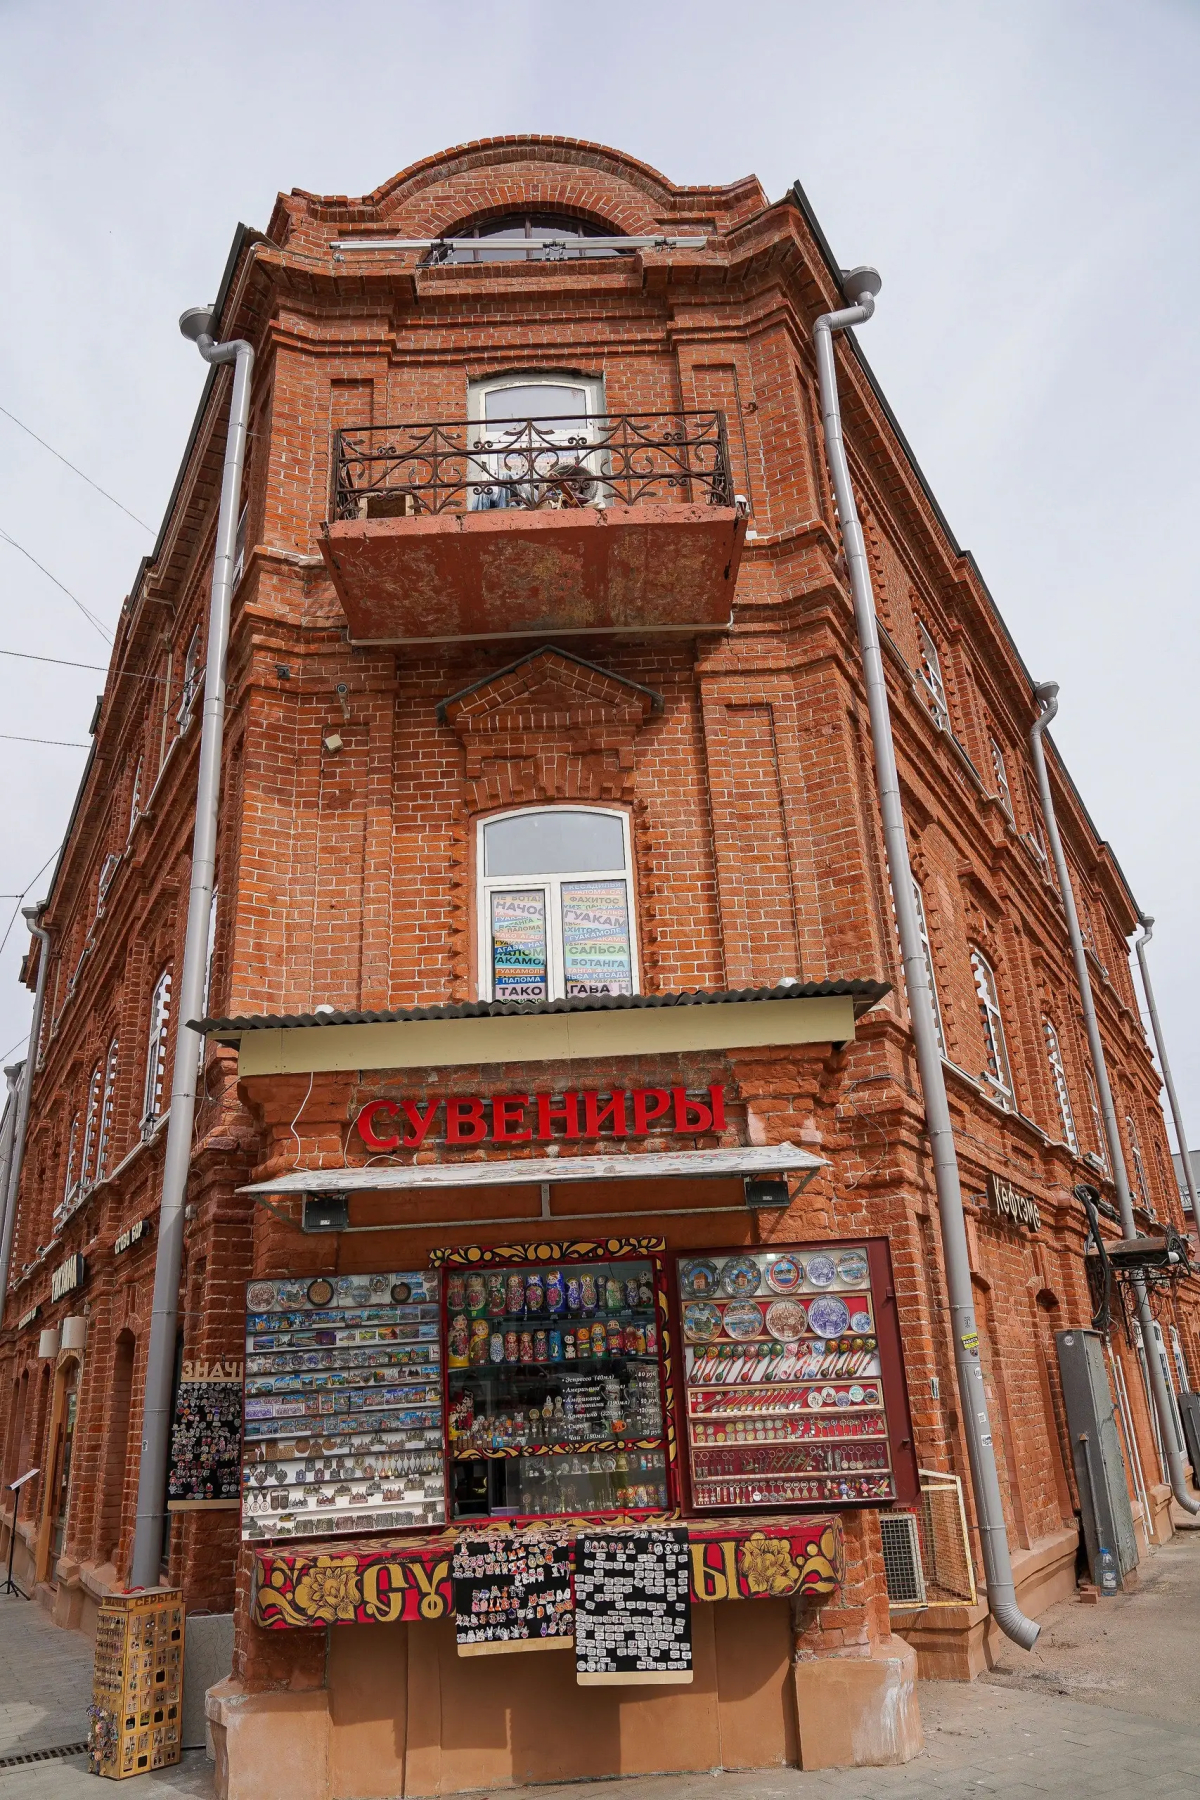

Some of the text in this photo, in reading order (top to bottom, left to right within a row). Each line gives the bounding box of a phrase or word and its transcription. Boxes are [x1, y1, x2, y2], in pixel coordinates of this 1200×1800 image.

[569, 896, 620, 905] ФАХИТОС
[568, 945, 627, 955] САЛЬСА
[571, 958, 626, 968] БОТАНГА
[502, 976, 542, 984] ПАЛОМА
[498, 986, 543, 997] ТАКО
[567, 983, 611, 994] ГАВА
[358, 1085, 728, 1148] СУВЕНИРЫ
[134, 1591, 178, 1608] СЕРЬГИ
